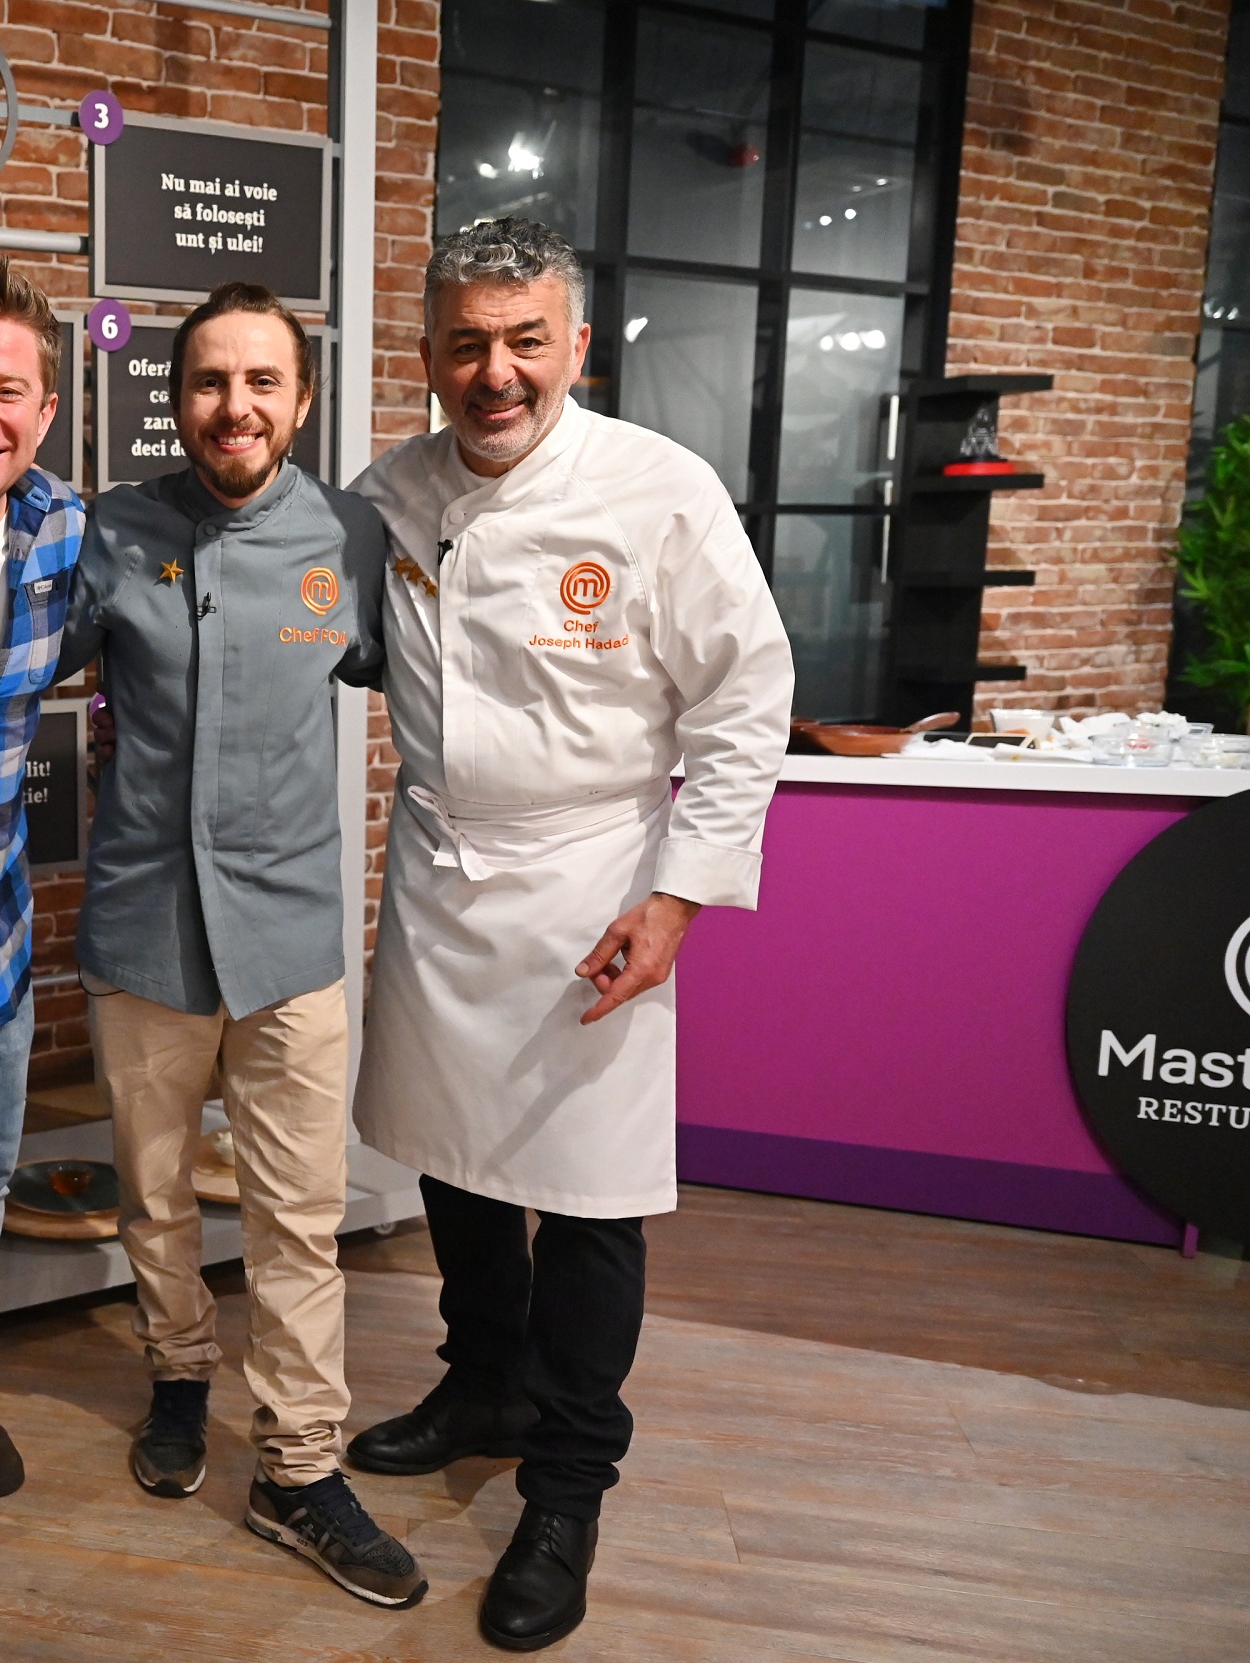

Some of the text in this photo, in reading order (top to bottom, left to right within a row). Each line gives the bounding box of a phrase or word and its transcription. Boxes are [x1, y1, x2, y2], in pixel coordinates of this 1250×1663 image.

[93, 102, 110, 129] 3
[160, 173, 278, 201] Nu mai ai voie
[173, 203, 266, 231] să folosești
[175, 232, 264, 255] unt și ulei!
[101, 314, 119, 340] 6
[149, 390, 170, 404] co
[131, 438, 167, 457] deci
[279, 627, 320, 643] Chef
[563, 619, 600, 633] Chef
[528, 634, 630, 650] Joseph Hadad
[1136, 1096, 1250, 1130] RESTU
